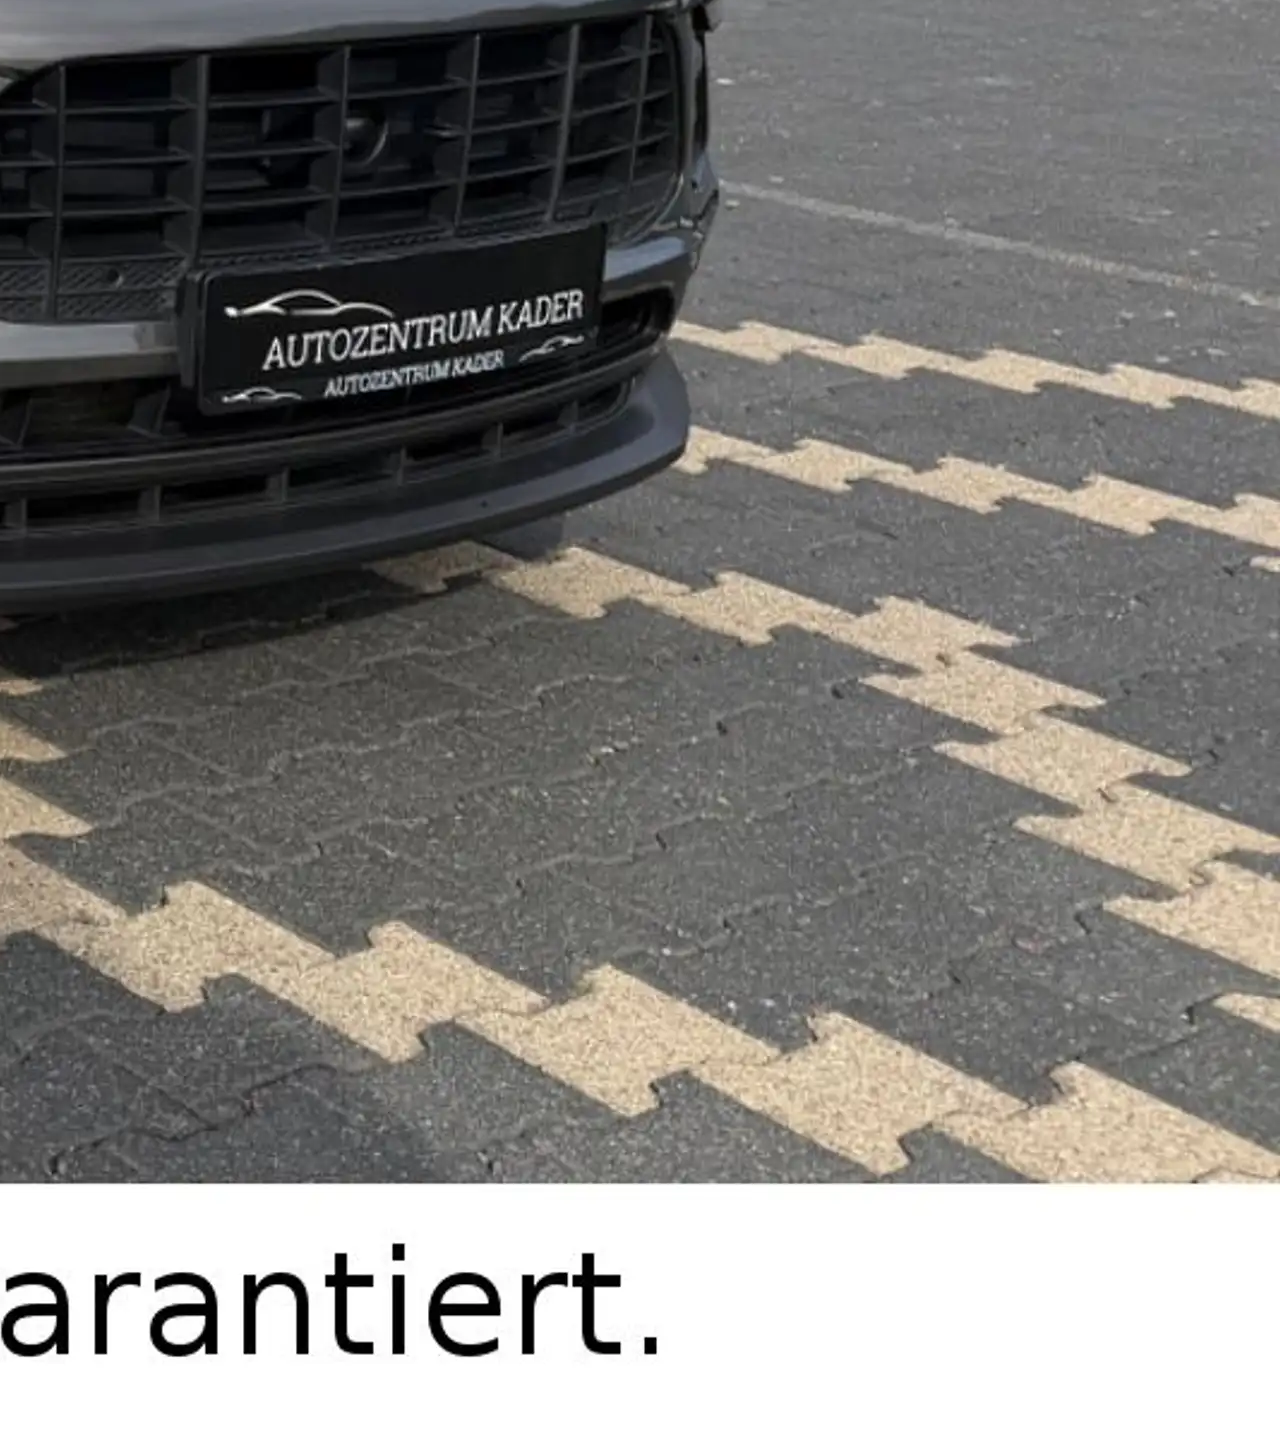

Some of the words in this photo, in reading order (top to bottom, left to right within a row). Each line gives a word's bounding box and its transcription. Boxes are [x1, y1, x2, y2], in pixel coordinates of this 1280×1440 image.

[261, 304, 495, 371] AUTOZENTRUM
[496, 288, 585, 336] KADER
[323, 361, 452, 399] AUTOZENTRUM
[450, 348, 505, 378] KADER
